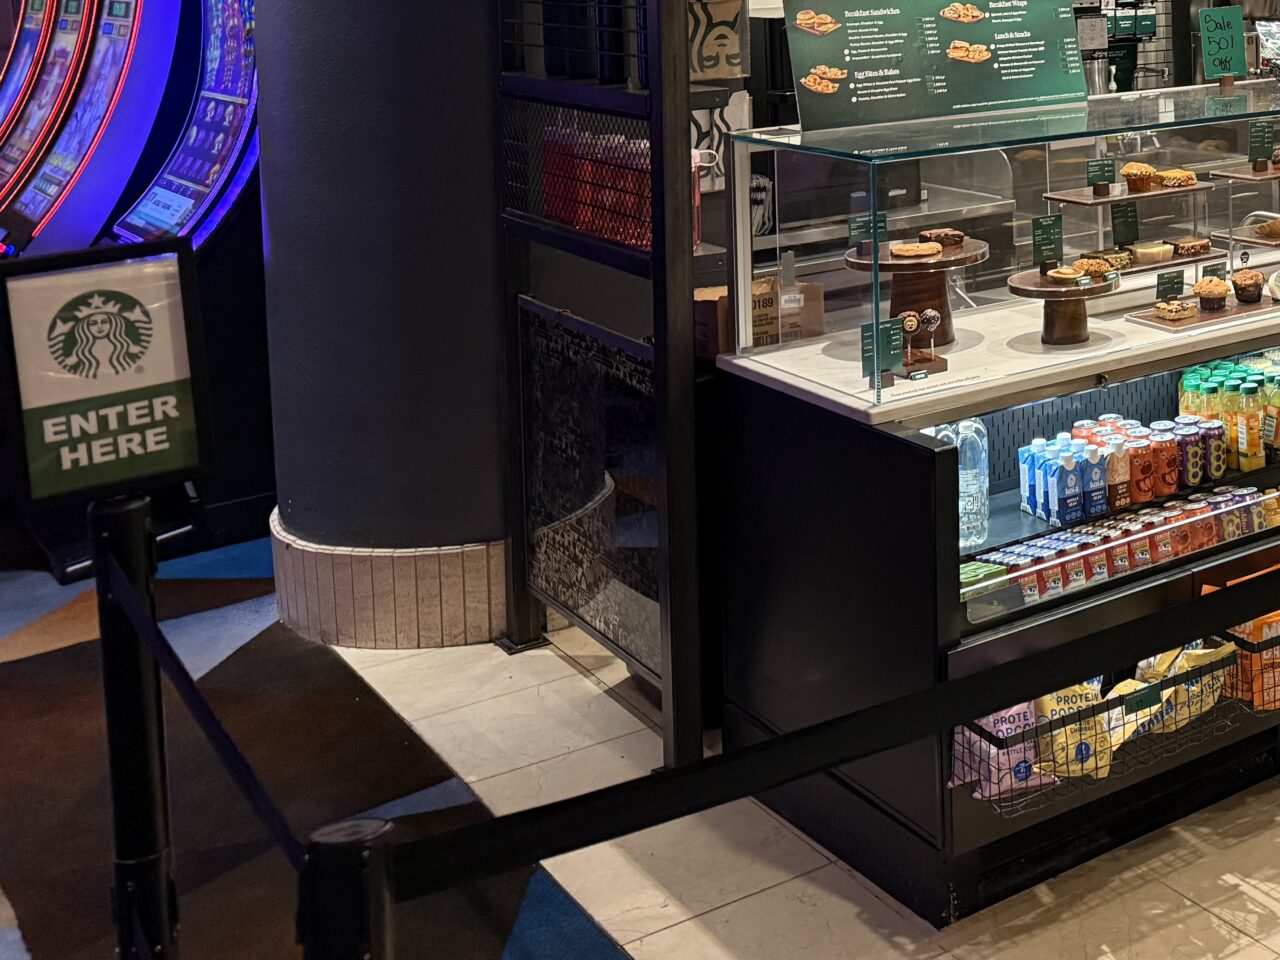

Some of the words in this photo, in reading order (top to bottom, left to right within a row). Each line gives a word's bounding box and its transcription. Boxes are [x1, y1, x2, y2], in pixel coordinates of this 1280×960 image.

[988, 0, 1012, 8] Breakfast
[844, 9, 870, 18] Breakfast
[870, 7, 901, 17] Sandwiches
[1204, 13, 1233, 33] Sale
[994, 32, 1009, 40] Lunch
[1212, 56, 1233, 71] off
[854, 71, 866, 80] Egg
[42, 394, 180, 443] ENTER
[59, 426, 170, 470] HERE
[1056, 692, 1100, 706] PROTEIN
